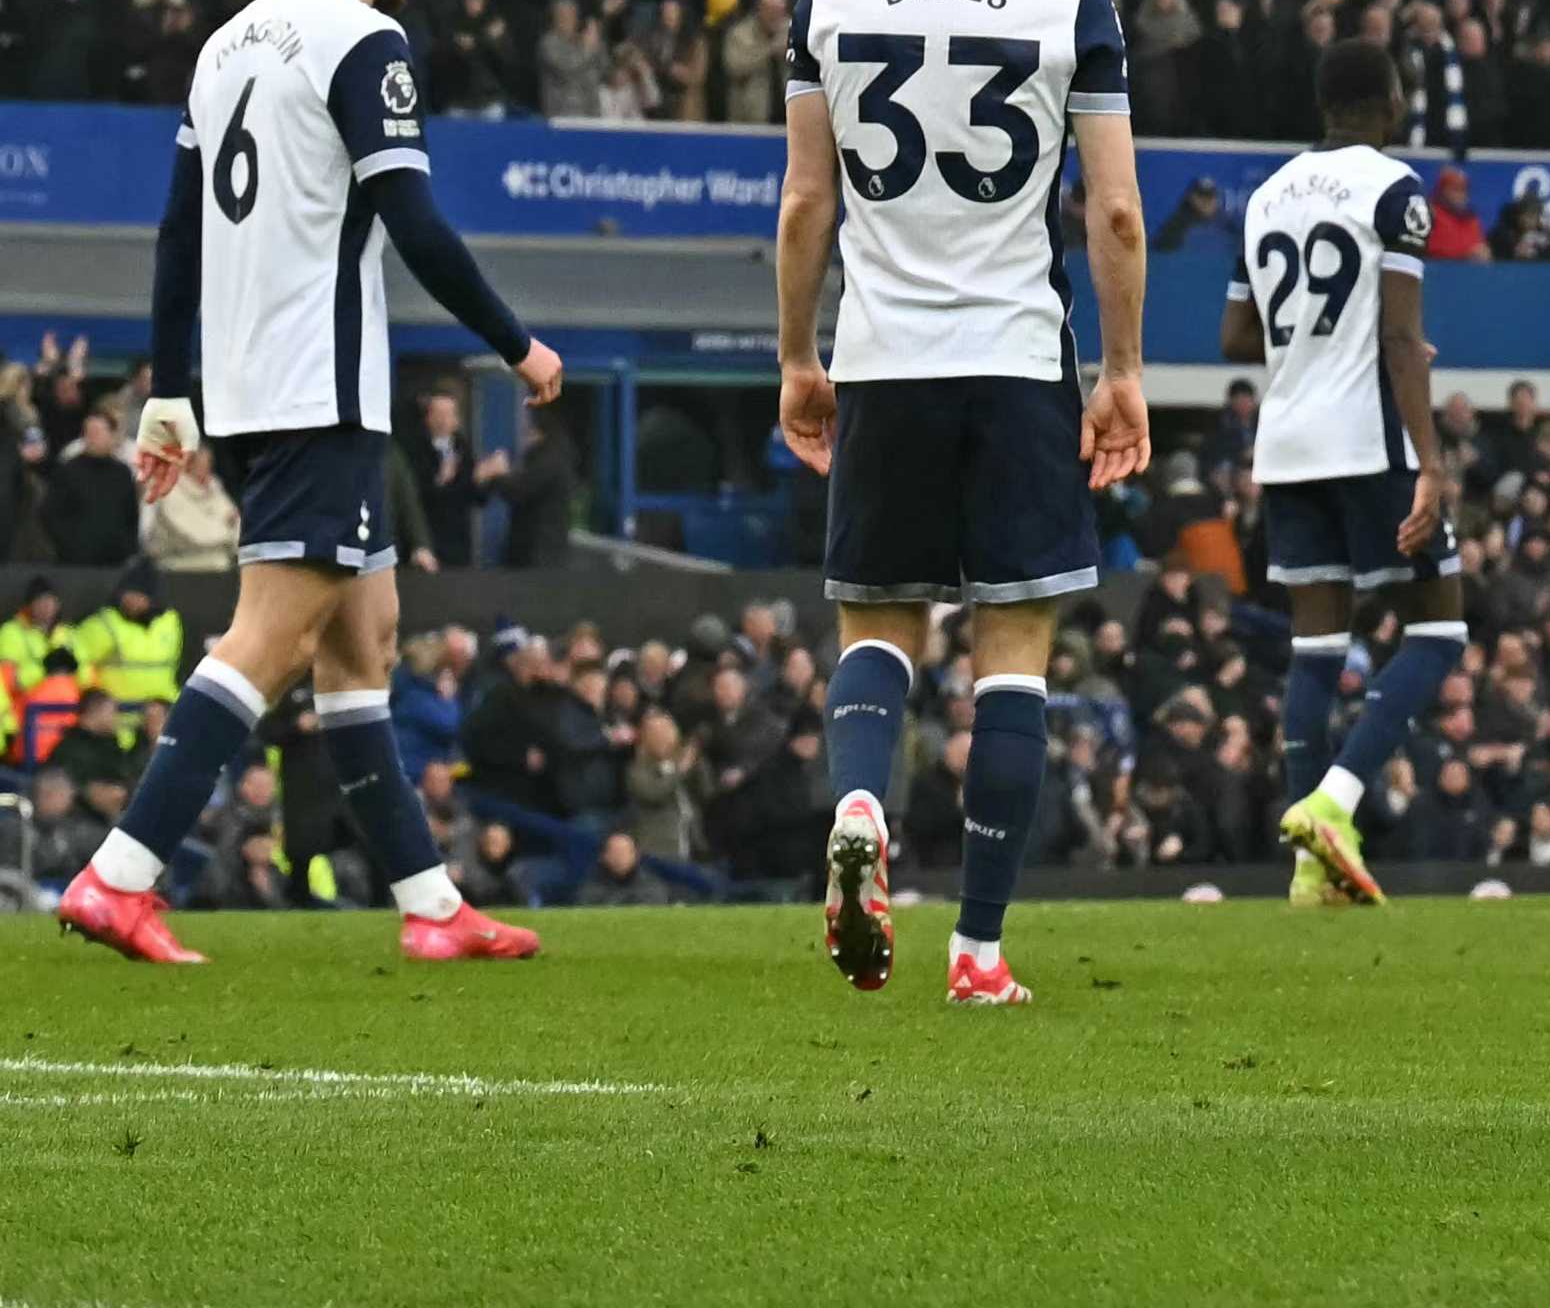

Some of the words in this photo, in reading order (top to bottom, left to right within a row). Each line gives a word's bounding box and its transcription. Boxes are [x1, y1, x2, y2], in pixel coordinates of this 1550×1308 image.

[213, 75, 259, 226] 6
[550, 162, 703, 211] Christopher
[704, 169, 778, 207] Ward
[837, 32, 1041, 204] 33
[1257, 220, 1362, 348] 29
